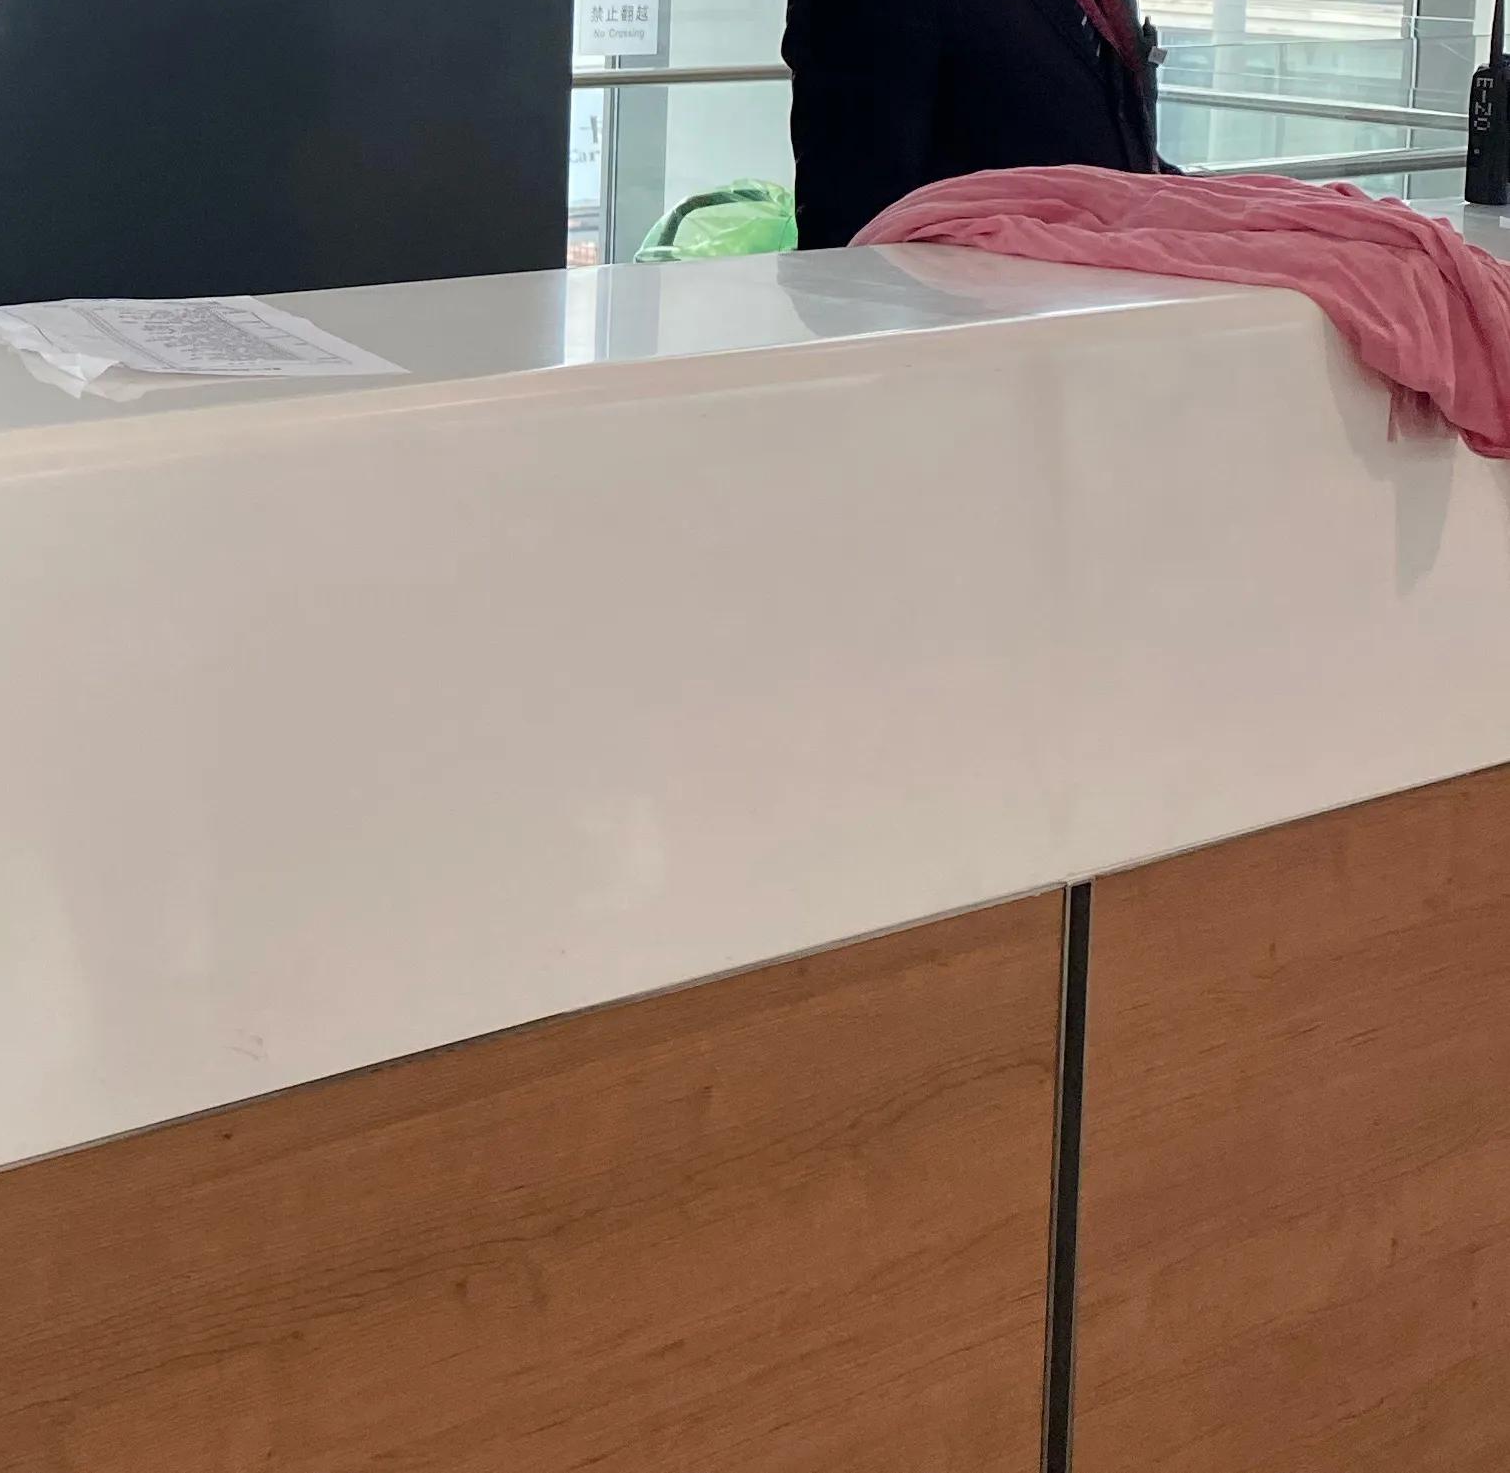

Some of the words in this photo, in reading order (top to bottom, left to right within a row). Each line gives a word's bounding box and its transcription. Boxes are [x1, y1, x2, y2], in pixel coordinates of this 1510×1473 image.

[590, 4, 649, 23] 禁止翻越
[594, 29, 605, 39] No
